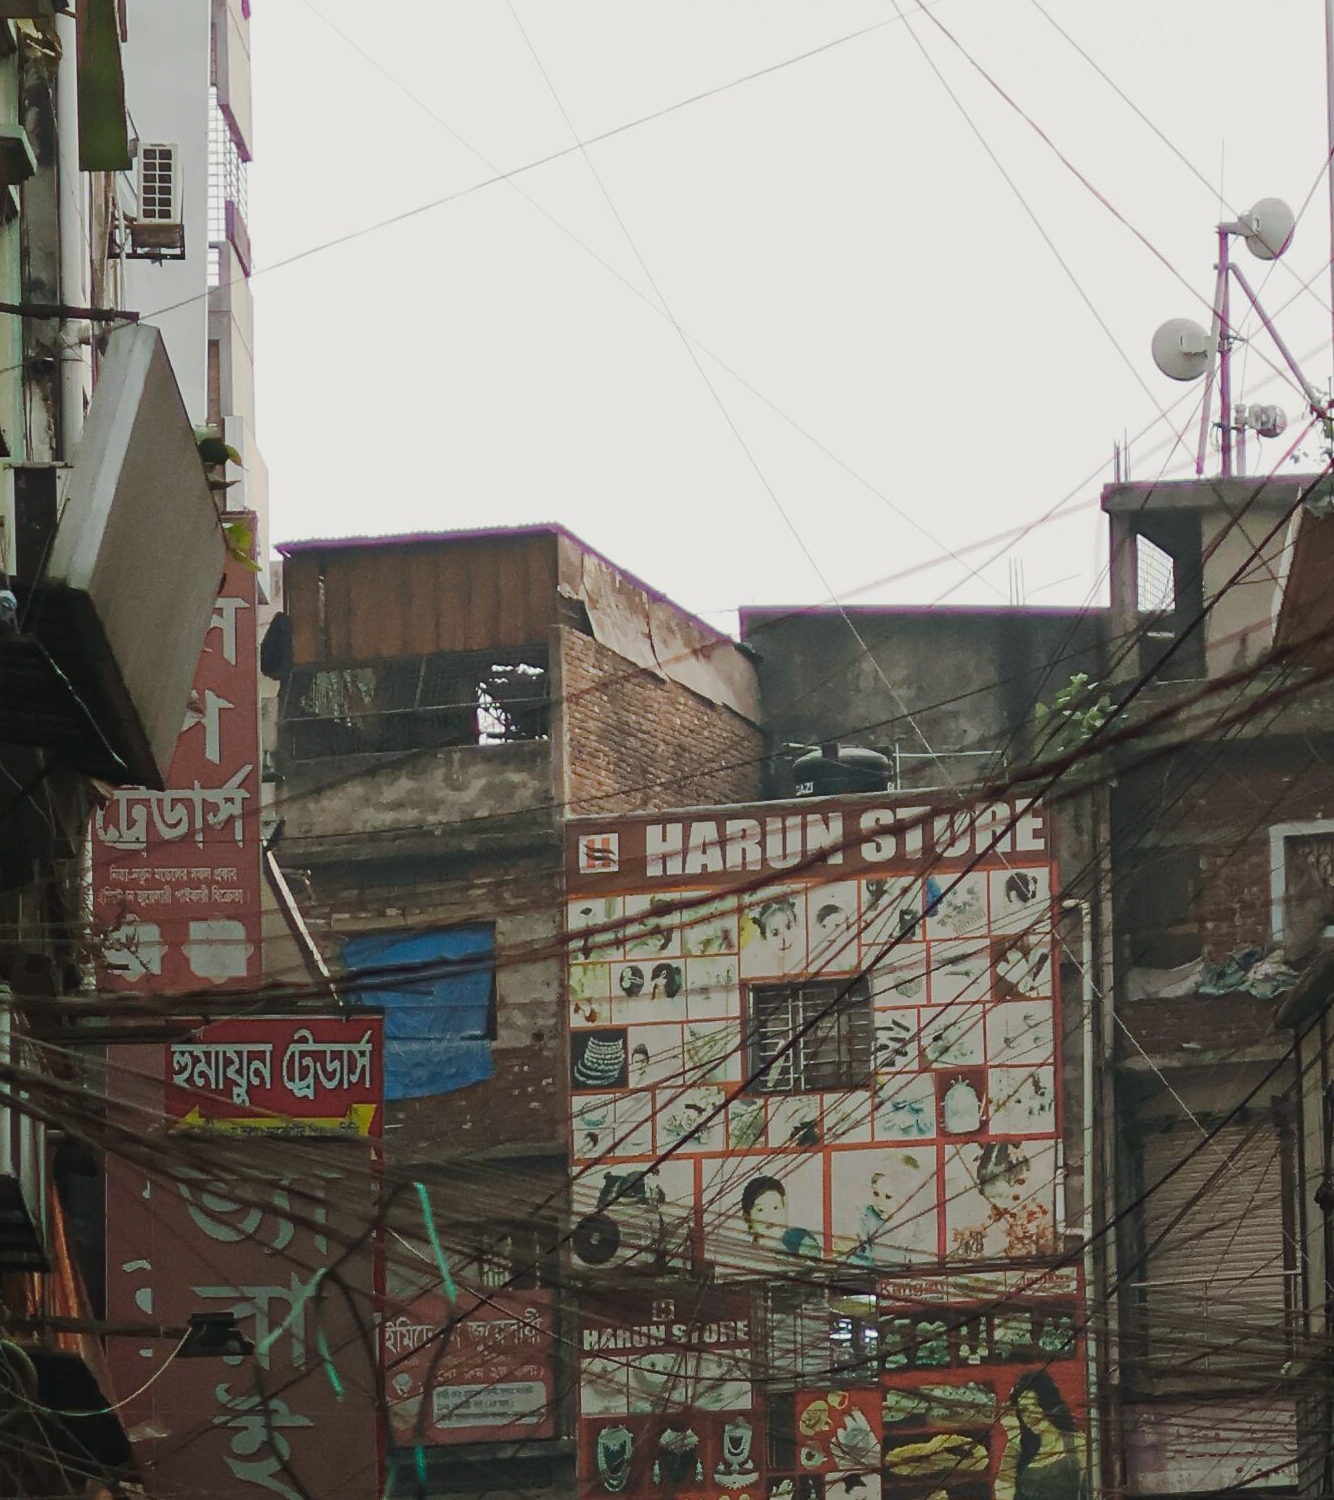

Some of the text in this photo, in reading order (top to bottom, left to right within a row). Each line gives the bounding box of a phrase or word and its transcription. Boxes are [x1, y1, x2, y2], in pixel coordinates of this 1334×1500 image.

[645, 797, 1046, 878] HARUN STORE
[582, 1318, 749, 1352] HARUN STORE
